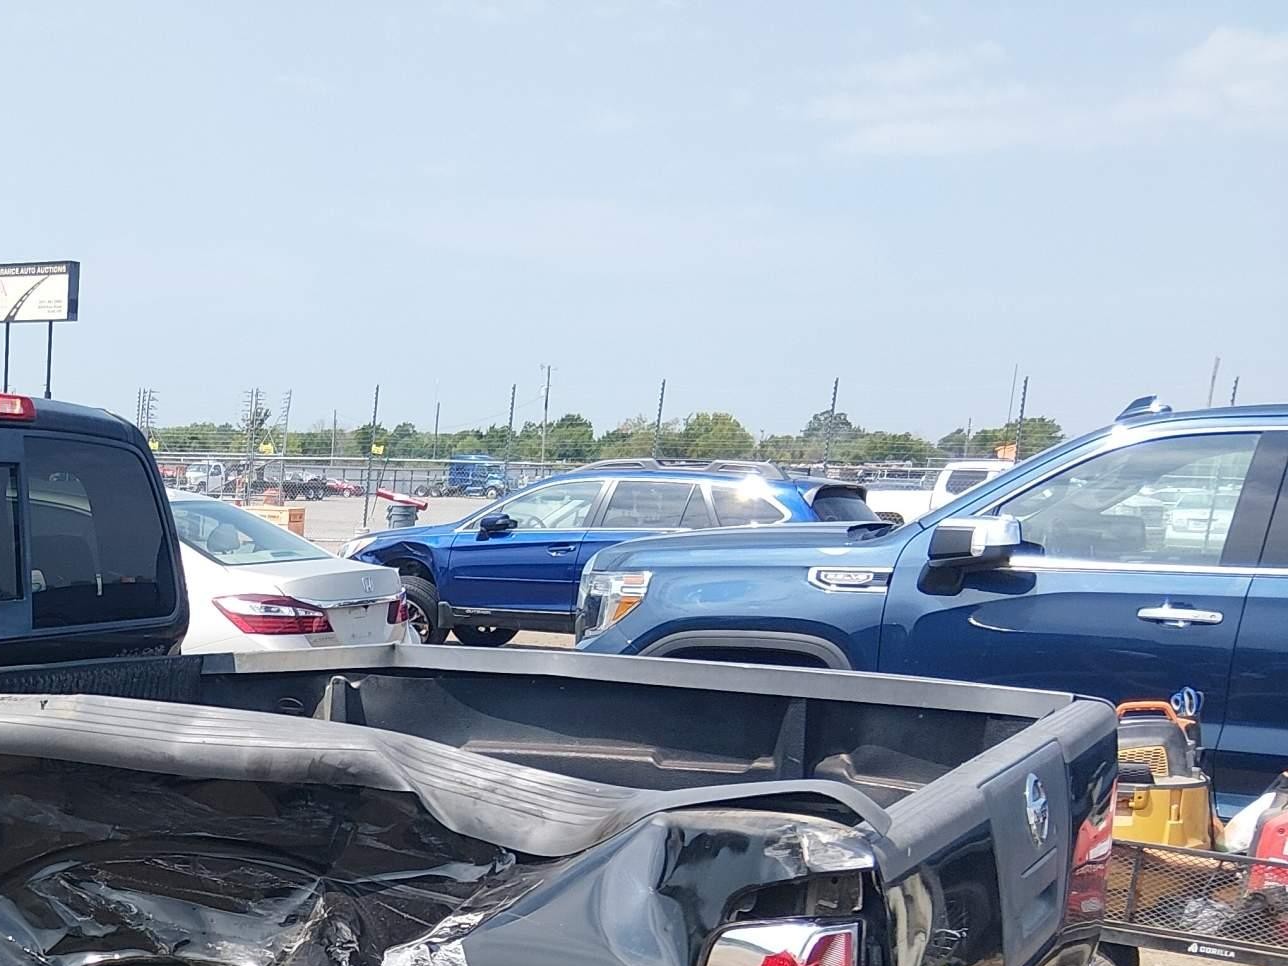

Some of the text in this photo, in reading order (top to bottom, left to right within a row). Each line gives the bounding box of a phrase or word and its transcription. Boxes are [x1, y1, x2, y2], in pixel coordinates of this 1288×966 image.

[20, 266, 36, 275] AUTO
[37, 265, 67, 274] AUCTIONS
[1199, 946, 1236, 958] GORILLA
